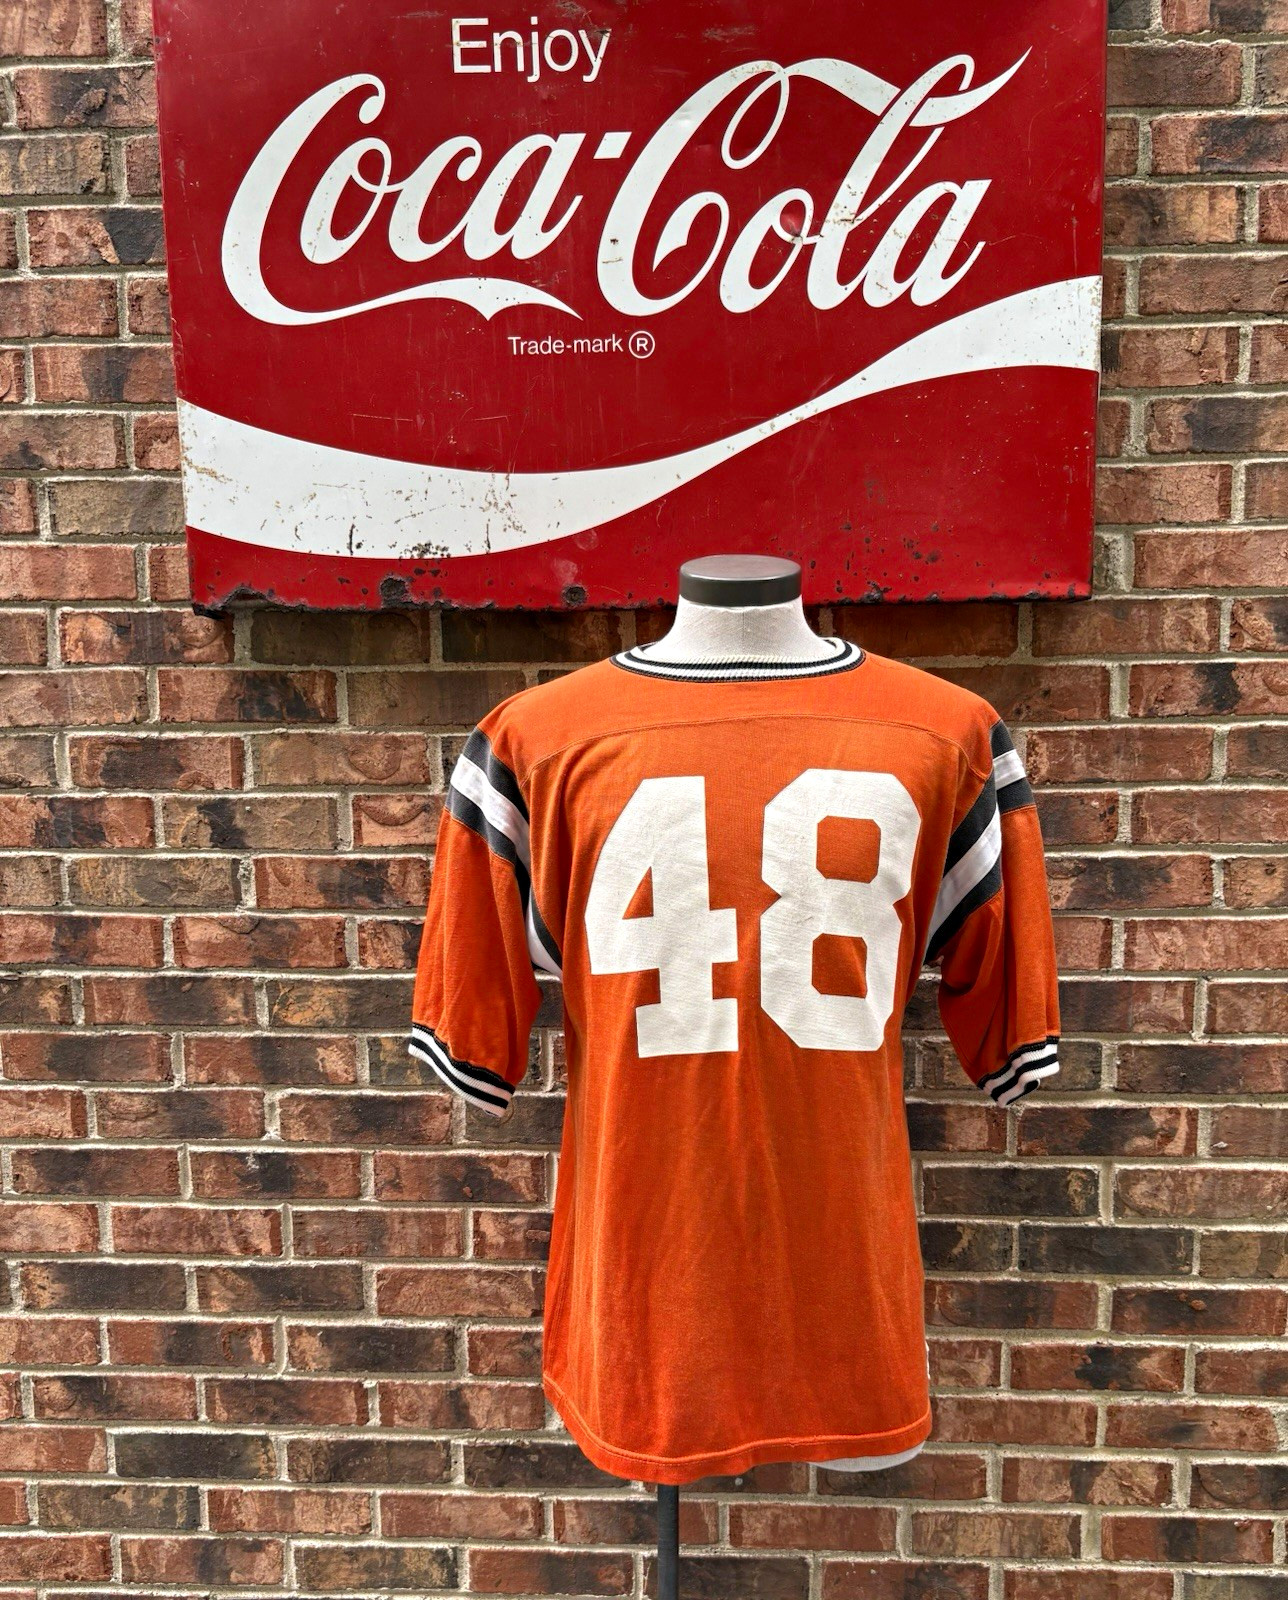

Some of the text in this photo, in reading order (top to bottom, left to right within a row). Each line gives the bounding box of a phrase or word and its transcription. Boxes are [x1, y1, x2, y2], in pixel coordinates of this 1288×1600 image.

[451, 16, 611, 83] Enjoy
[221, 46, 1032, 326] Coca-Cola
[507, 334, 624, 355] Trade-mark
[585, 768, 922, 1059] 48
